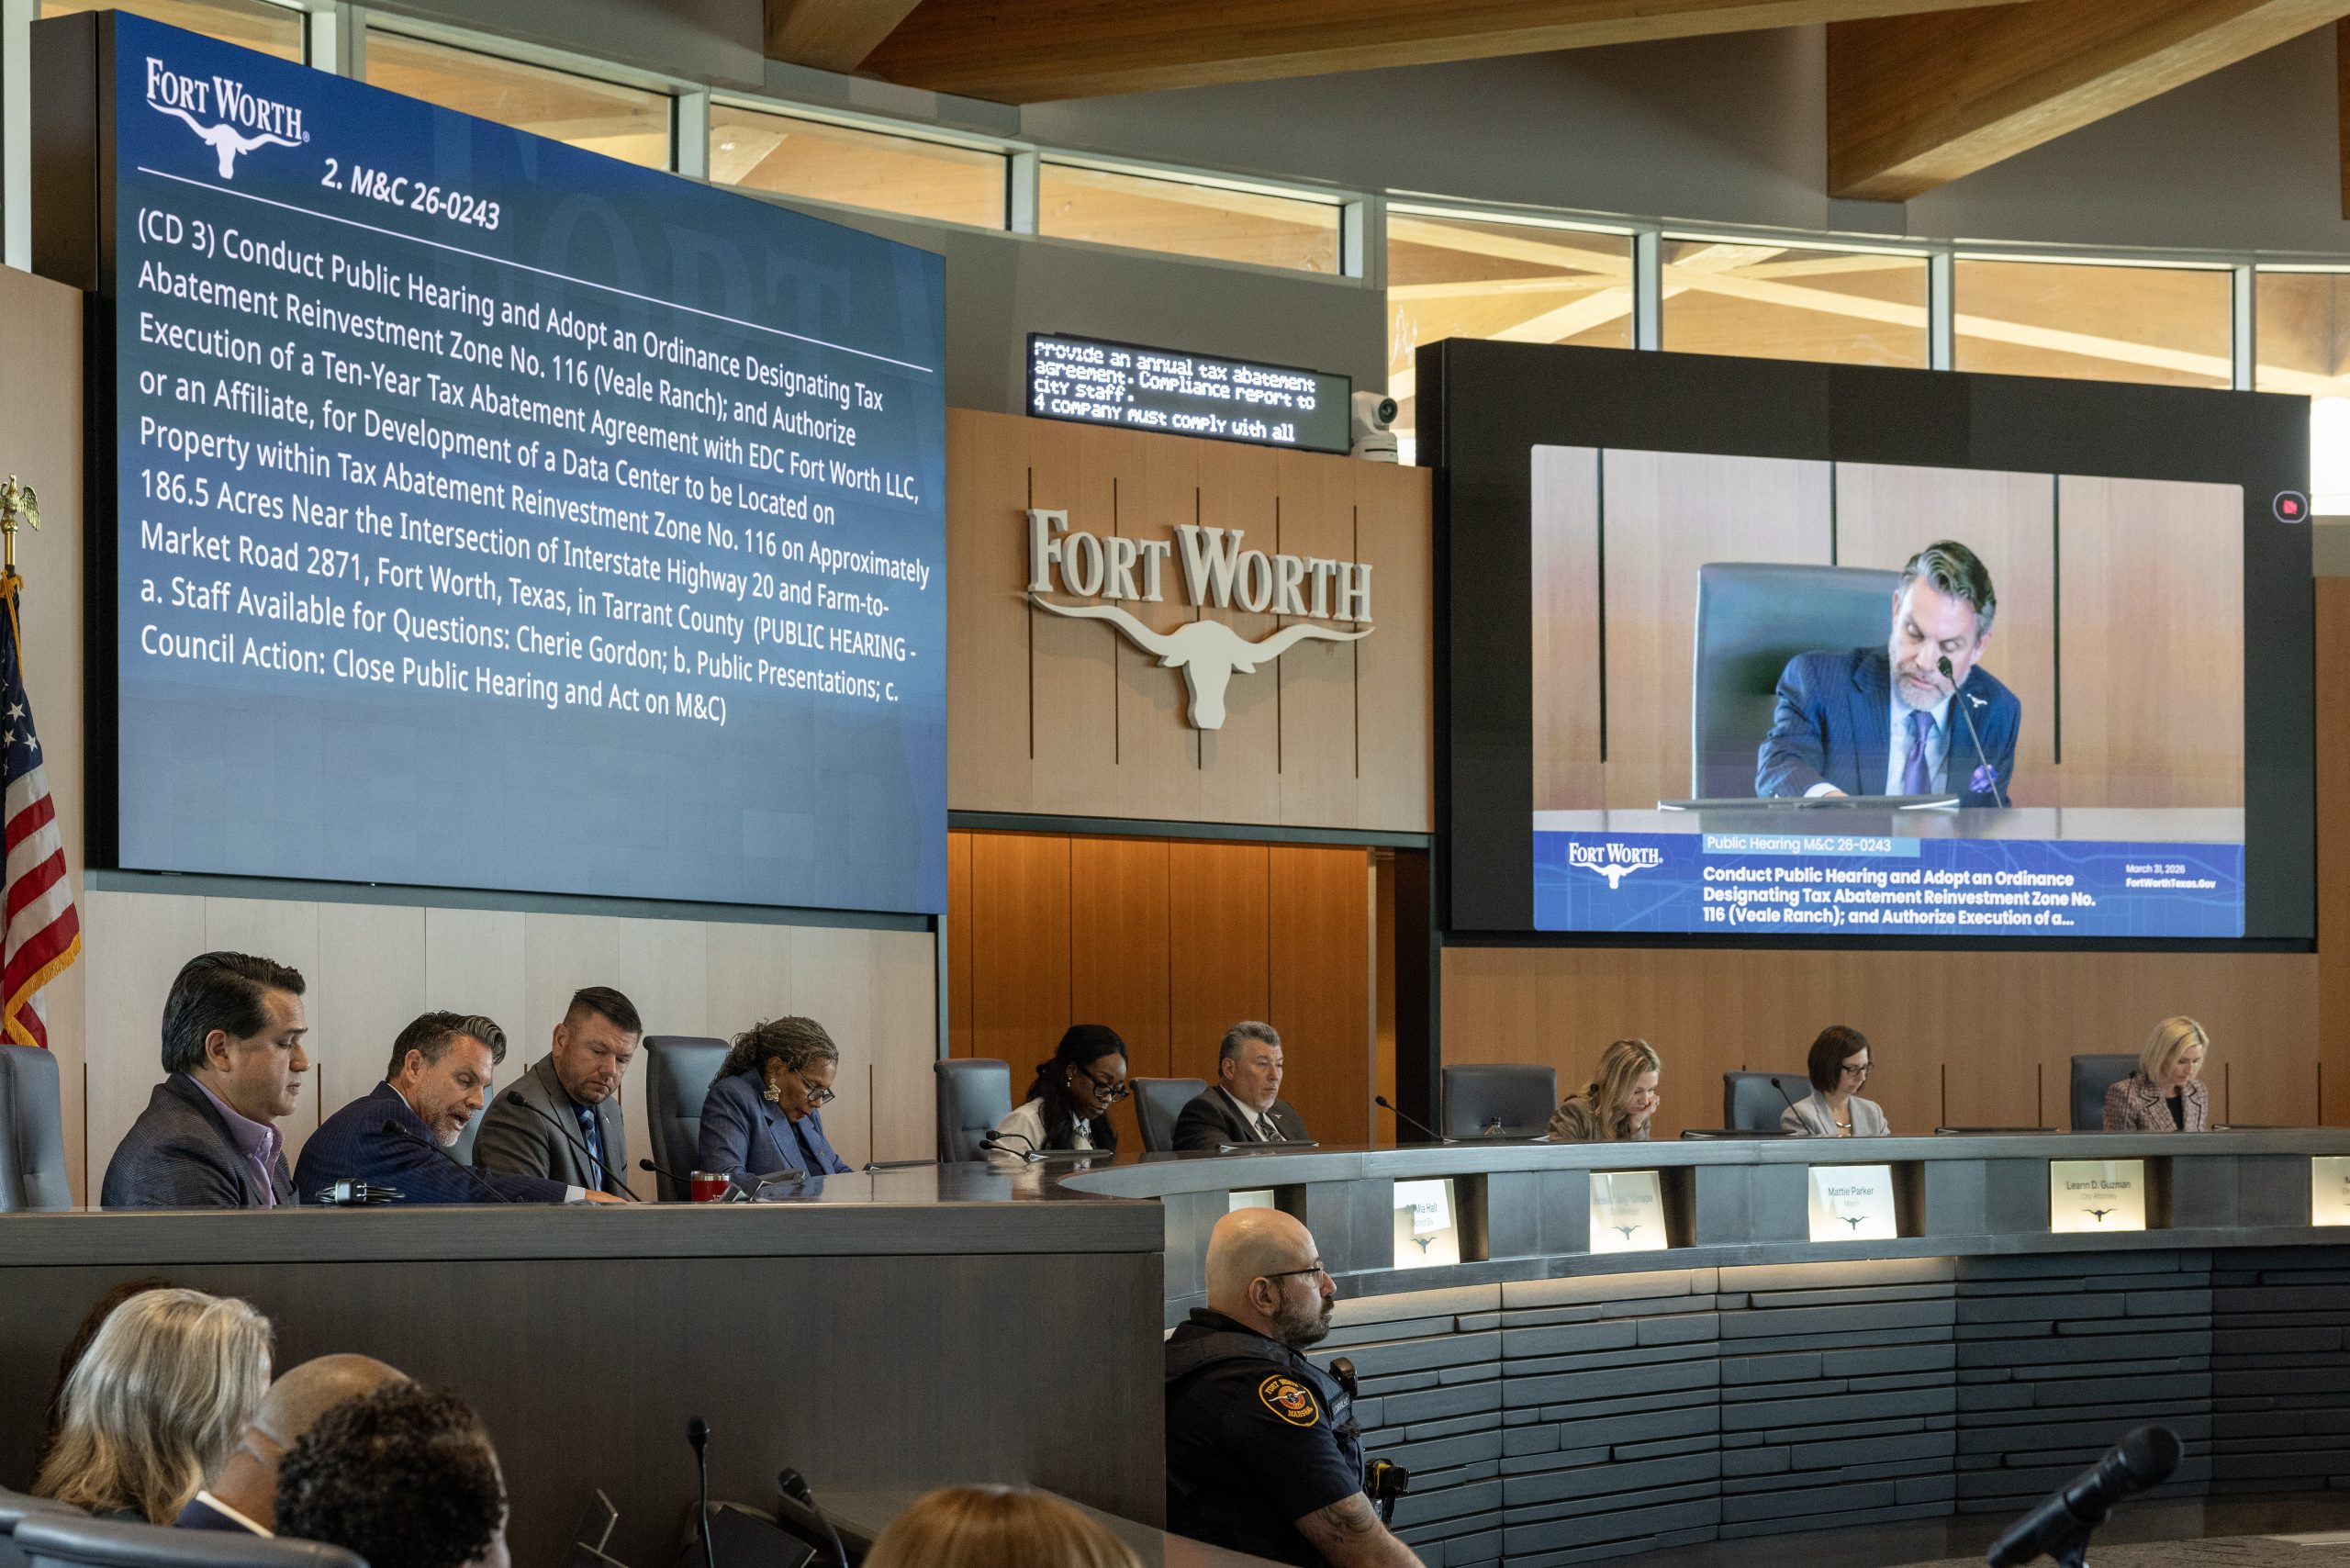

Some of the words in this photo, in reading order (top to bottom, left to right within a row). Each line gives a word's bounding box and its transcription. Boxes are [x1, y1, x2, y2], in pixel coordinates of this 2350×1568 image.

[146, 56, 209, 114] FORT
[212, 75, 302, 140] WORTH
[321, 158, 342, 190] 2.
[351, 165, 408, 206] M&C
[410, 183, 499, 230] 26-0243
[139, 207, 183, 244] (CD
[192, 220, 215, 258] 3)
[224, 229, 323, 279] Conduct
[332, 254, 400, 297] Public
[408, 274, 494, 327] Hearing
[501, 302, 539, 330] and
[546, 308, 607, 351] Adopt
[613, 330, 636, 353] an
[643, 331, 740, 377] Ordinance
[746, 356, 849, 410] Designating
[855, 382, 883, 411] Tax
[139, 261, 278, 319] Abatement
[287, 294, 443, 355] Reinvestment
[450, 330, 503, 368] Zone
[511, 345, 544, 377] No.
[553, 355, 588, 386] 116
[595, 364, 653, 401] (Veale
[660, 379, 727, 421] Ranch);
[733, 401, 767, 426] and
[773, 406, 856, 446] Authorize
[1110, 352, 1131, 367] an
[1136, 355, 1193, 375] annual
[1198, 364, 1227, 380] tax
[1233, 366, 1315, 393] abatement
[140, 312, 261, 364] Execution
[270, 342, 295, 371] of
[301, 353, 313, 375] a
[321, 351, 420, 397] Ten-Year
[427, 374, 464, 407] Tax
[470, 384, 585, 432] Abatement
[591, 409, 699, 455] Agreement
[704, 436, 743, 465] with
[750, 442, 784, 473] EDC
[791, 452, 825, 482] Fort
[830, 460, 880, 493] Worth
[887, 472, 918, 504] LLC,
[1035, 360, 1134, 385] agreement.
[1139, 370, 1230, 399] Compliance
[1235, 386, 1292, 407] report
[1296, 395, 1315, 409] to
[1051, 398, 1122, 420] company
[1127, 408, 1167, 426] must
[1172, 413, 1226, 432] comply
[1232, 418, 1267, 438] with
[1271, 423, 1295, 442] all
[141, 416, 250, 471] Property
[256, 441, 330, 477] within
[338, 453, 376, 486] Tax
[384, 462, 505, 509] Abatement
[512, 485, 648, 534] Reinvestment
[655, 511, 700, 543] Zone
[709, 521, 738, 550] No.
[745, 529, 776, 556] 116
[782, 541, 803, 561] on
[809, 541, 929, 590] Approximately
[141, 469, 208, 507] 186.5
[217, 482, 283, 519] Acres
[293, 494, 349, 529] Near
[355, 505, 392, 537] the
[400, 512, 530, 559] Intersection
[538, 537, 559, 564] of
[565, 541, 660, 580] Interstate
[668, 558, 747, 601] Highway
[753, 573, 773, 599] 20
[779, 580, 811, 605] and
[818, 584, 889, 617] Farm-to-
[1026, 508, 1170, 602] FORT
[1173, 523, 1373, 623] WORTH
[142, 521, 230, 562] Market
[240, 535, 297, 571] Road
[308, 546, 369, 586] 2871,
[379, 557, 423, 590] Fort
[430, 566, 501, 605] Worth,
[509, 577, 570, 615] Texas,
[579, 588, 596, 615] in
[602, 592, 672, 627] Tarrant
[678, 604, 744, 644] County
[755, 616, 823, 649] (PUBLIC
[831, 628, 905, 661] HEARING
[141, 579, 162, 603] a.
[172, 577, 230, 611] Staff
[237, 587, 344, 627] Available
[352, 601, 386, 632] for
[394, 609, 509, 649] Questions:
[517, 626, 582, 659] Cherie
[589, 636, 666, 674] Gordon;
[675, 646, 690, 673] b.
[698, 651, 752, 681] Public
[759, 659, 879, 702] Presentations;
[886, 682, 898, 701] c.
[142, 624, 233, 663] Council
[242, 638, 324, 675] Action:
[334, 649, 394, 682] Close
[404, 657, 468, 691] Public
[476, 666, 557, 709] Hearing
[565, 680, 601, 707] and
[609, 684, 639, 711] Act
[646, 694, 668, 714] on
[677, 692, 725, 726] M&C)
[1569, 842, 1605, 862] FORT
[1606, 843, 1659, 863] WORTH
[1707, 836, 1747, 849] Public
[1750, 838, 1800, 854] Hearing
[1804, 838, 1834, 851] M&C
[1838, 838, 1891, 852] 26-0243
[2125, 864, 2153, 873] March
[1703, 866, 1773, 882] Conduct
[1774, 867, 1823, 882] Public
[1825, 868, 1887, 888] Hearing
[1889, 869, 1920, 884] and
[1923, 869, 1970, 889] Adopt
[1972, 873, 1993, 885] an
[1994, 869, 2074, 887] Ordinance
[1703, 885, 1799, 906] Designating
[1802, 888, 1831, 902] Tax
[1833, 888, 1922, 904] Abatement
[1924, 889, 2030, 905] Reinvestment
[2031, 891, 2069, 906] Zone
[2071, 892, 2096, 906] No.
[1703, 907, 1725, 922] 116
[1729, 904, 1781, 925] (Veale
[1783, 905, 1845, 926] Ranch);
[1848, 909, 1879, 924] and
[1881, 908, 1956, 924] Authorize
[1958, 909, 2031, 925] Execution
[2034, 910, 2050, 925] of
[2052, 913, 2075, 925] a...
[1426, 1202, 1438, 1213] Hall
[1828, 1187, 1850, 1196] Mattie
[1851, 1186, 1874, 1195] Parker
[2066, 1181, 2090, 1190] Leann
[2100, 1180, 2131, 1189] Guzman
